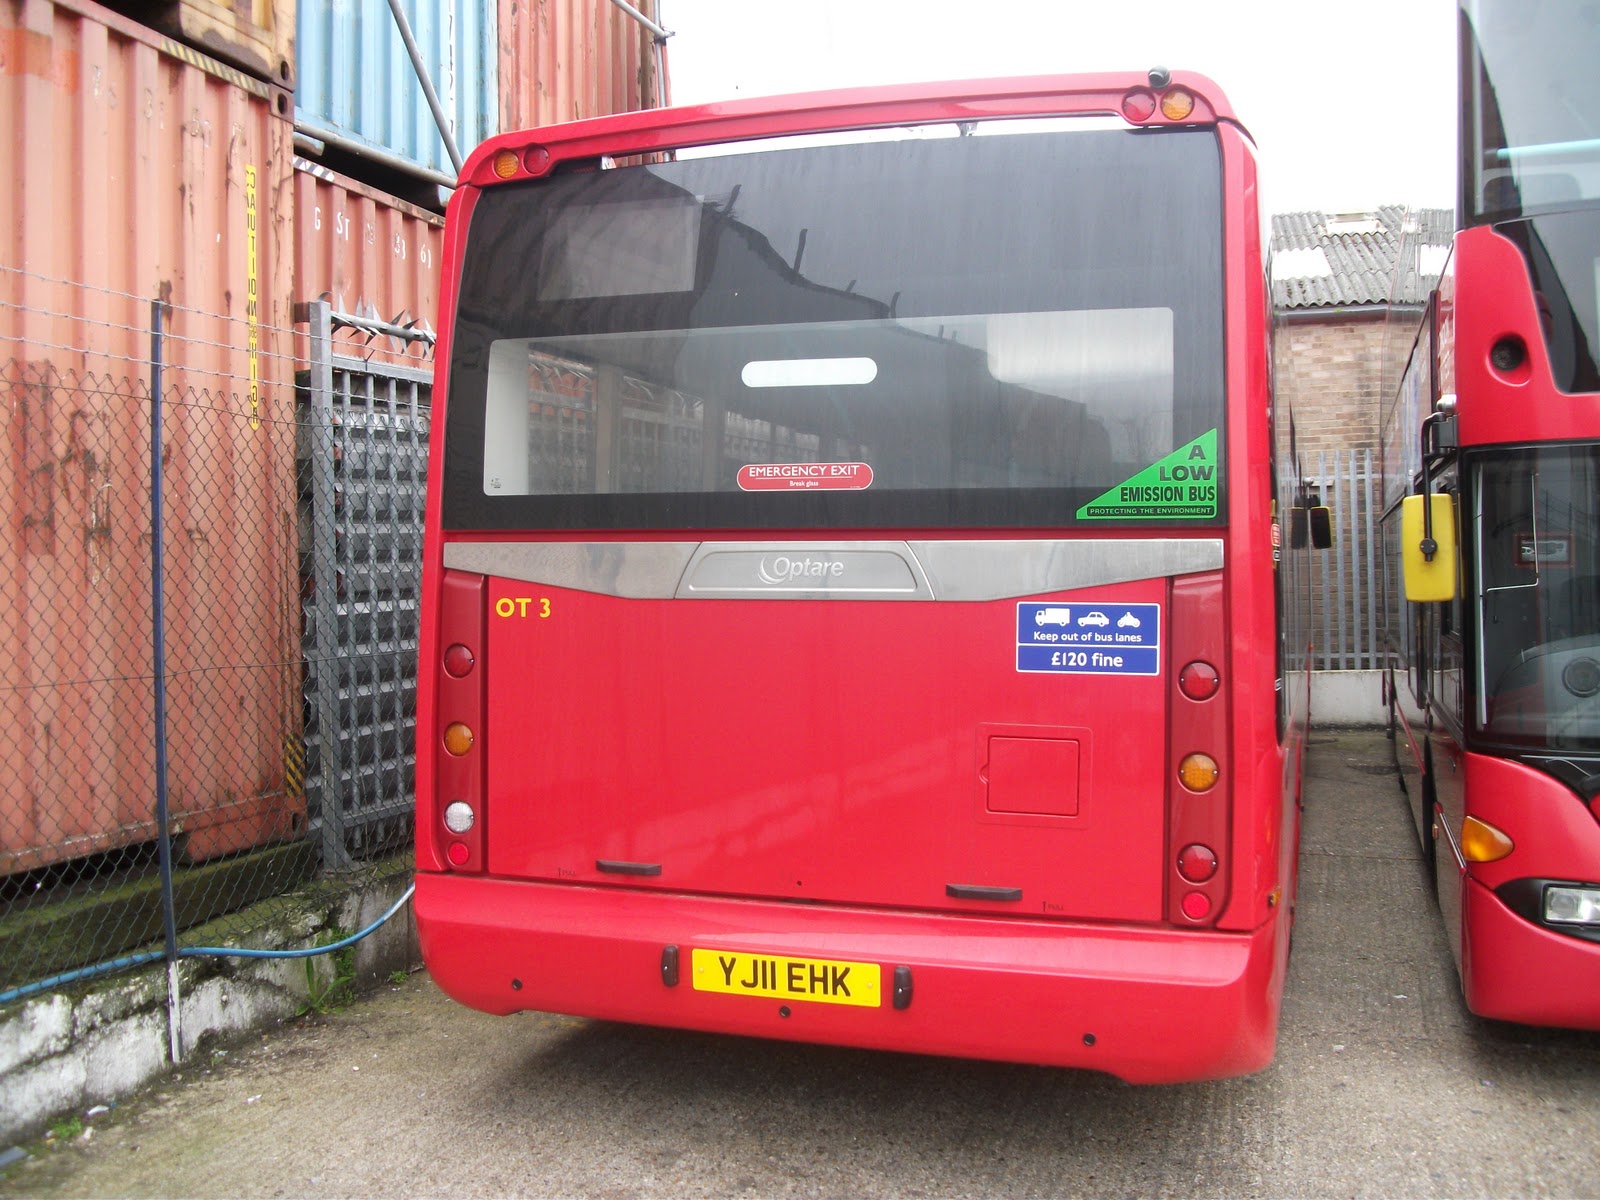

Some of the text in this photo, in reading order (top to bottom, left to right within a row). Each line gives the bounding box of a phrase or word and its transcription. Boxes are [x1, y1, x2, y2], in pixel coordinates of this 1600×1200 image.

[1188, 444, 1206, 460] A
[749, 465, 860, 478] EMERGENCY EXIT
[1160, 465, 1214, 481] LOW
[1120, 486, 1215, 502] EMISSION BUS
[773, 556, 844, 582] Optare
[495, 597, 551, 618] OT 3
[1033, 631, 1142, 643] Keep out of bus lanes
[1051, 652, 1124, 668] £120 fine
[718, 956, 852, 997] YJ11 EHK
